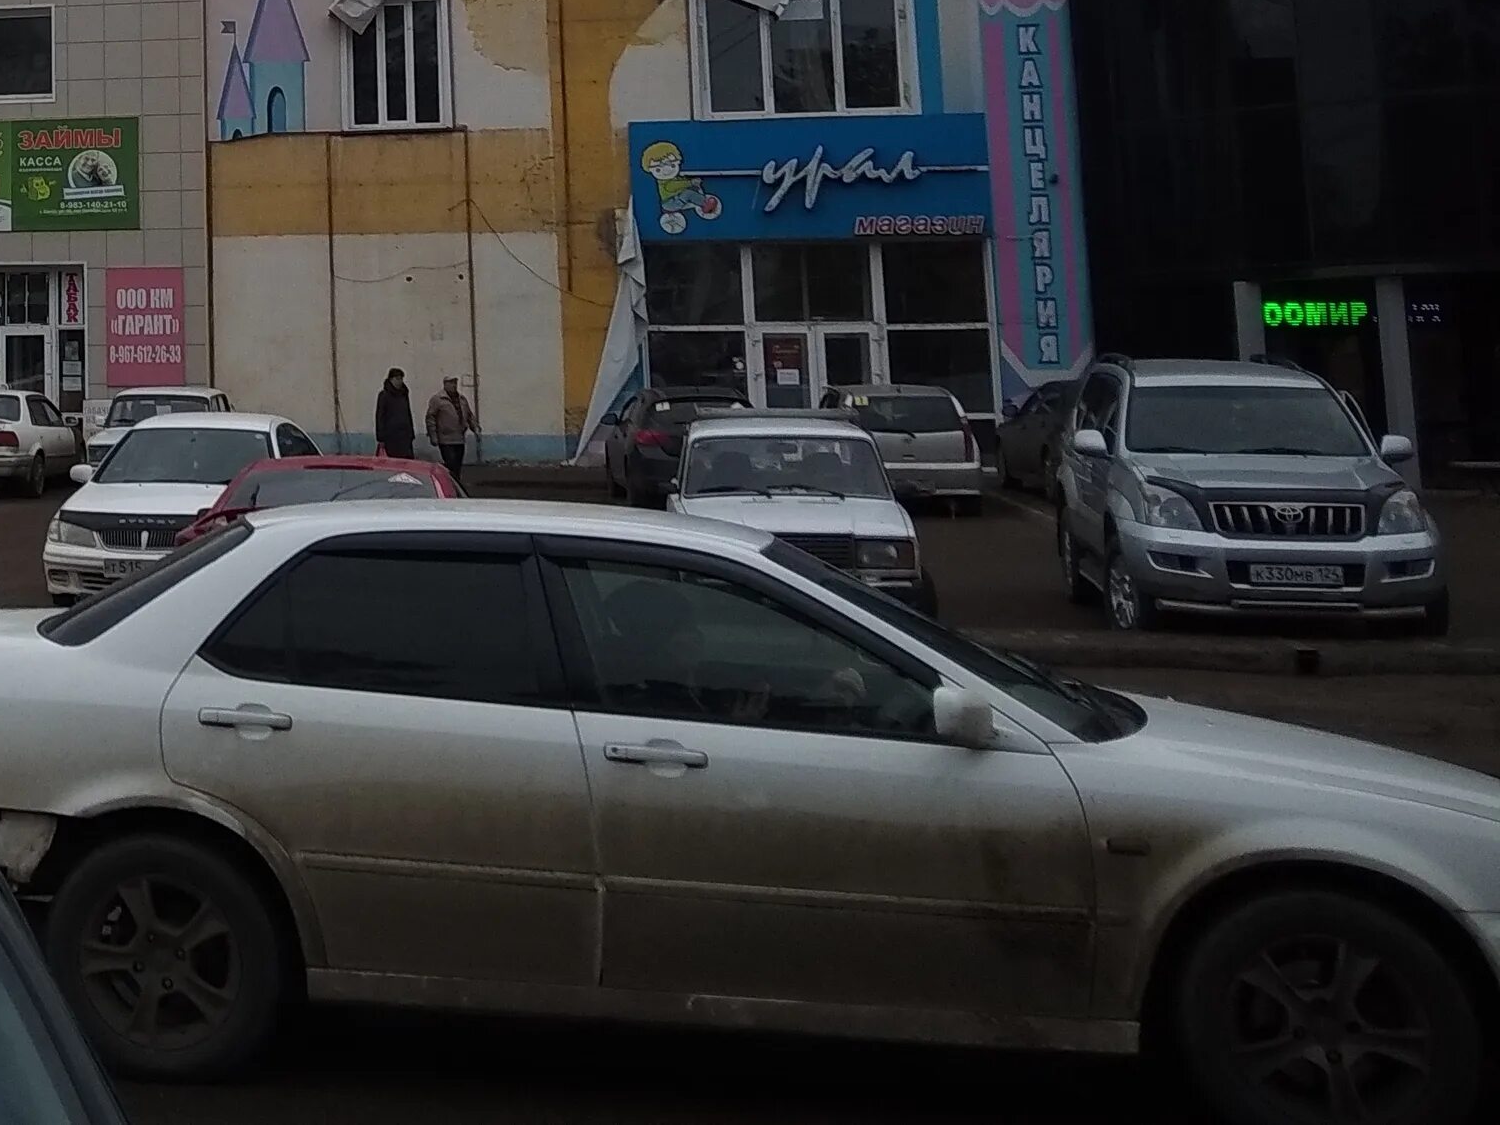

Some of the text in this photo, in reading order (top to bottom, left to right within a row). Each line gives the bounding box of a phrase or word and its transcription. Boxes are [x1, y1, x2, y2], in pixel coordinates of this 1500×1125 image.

[18, 125, 122, 150] ЗАЙМЫ
[19, 156, 62, 167] КАССА
[1016, 23, 1061, 365] КАНЦЕЛЯРИЯ
[853, 215, 986, 237] магазин
[65, 272, 79, 323] ТАБАК
[116, 288, 147, 310] ООО
